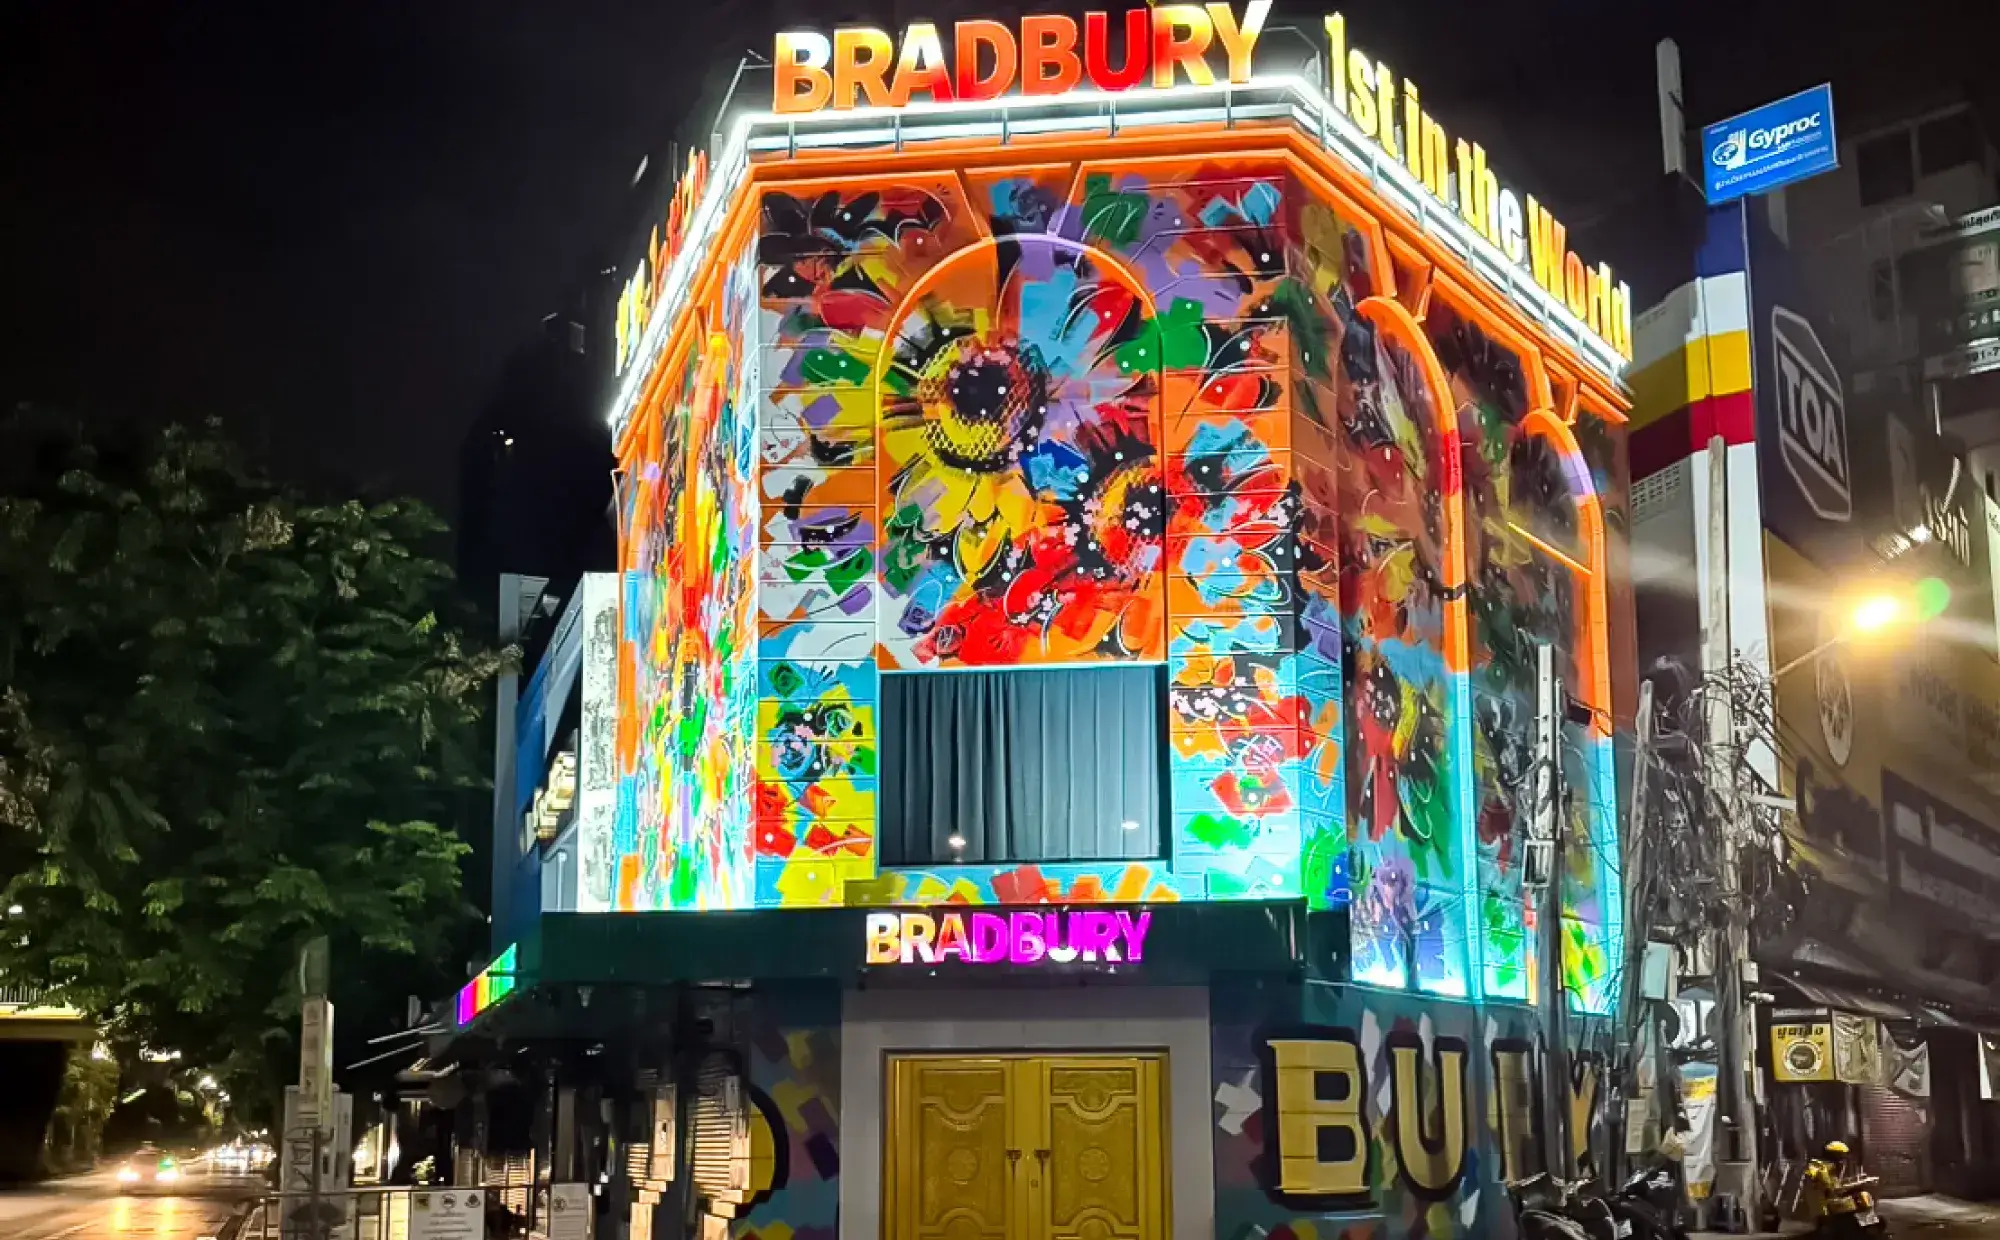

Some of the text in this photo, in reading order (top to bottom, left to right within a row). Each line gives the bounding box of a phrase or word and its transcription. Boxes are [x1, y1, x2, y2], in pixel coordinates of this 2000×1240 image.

[772, 0, 1274, 114] BRADBURY
[1325, 11, 1632, 362] 1st in the World
[1748, 111, 1820, 149] Gyproc
[1777, 353, 1846, 479] TOA
[865, 911, 1151, 964] BRADBURY
